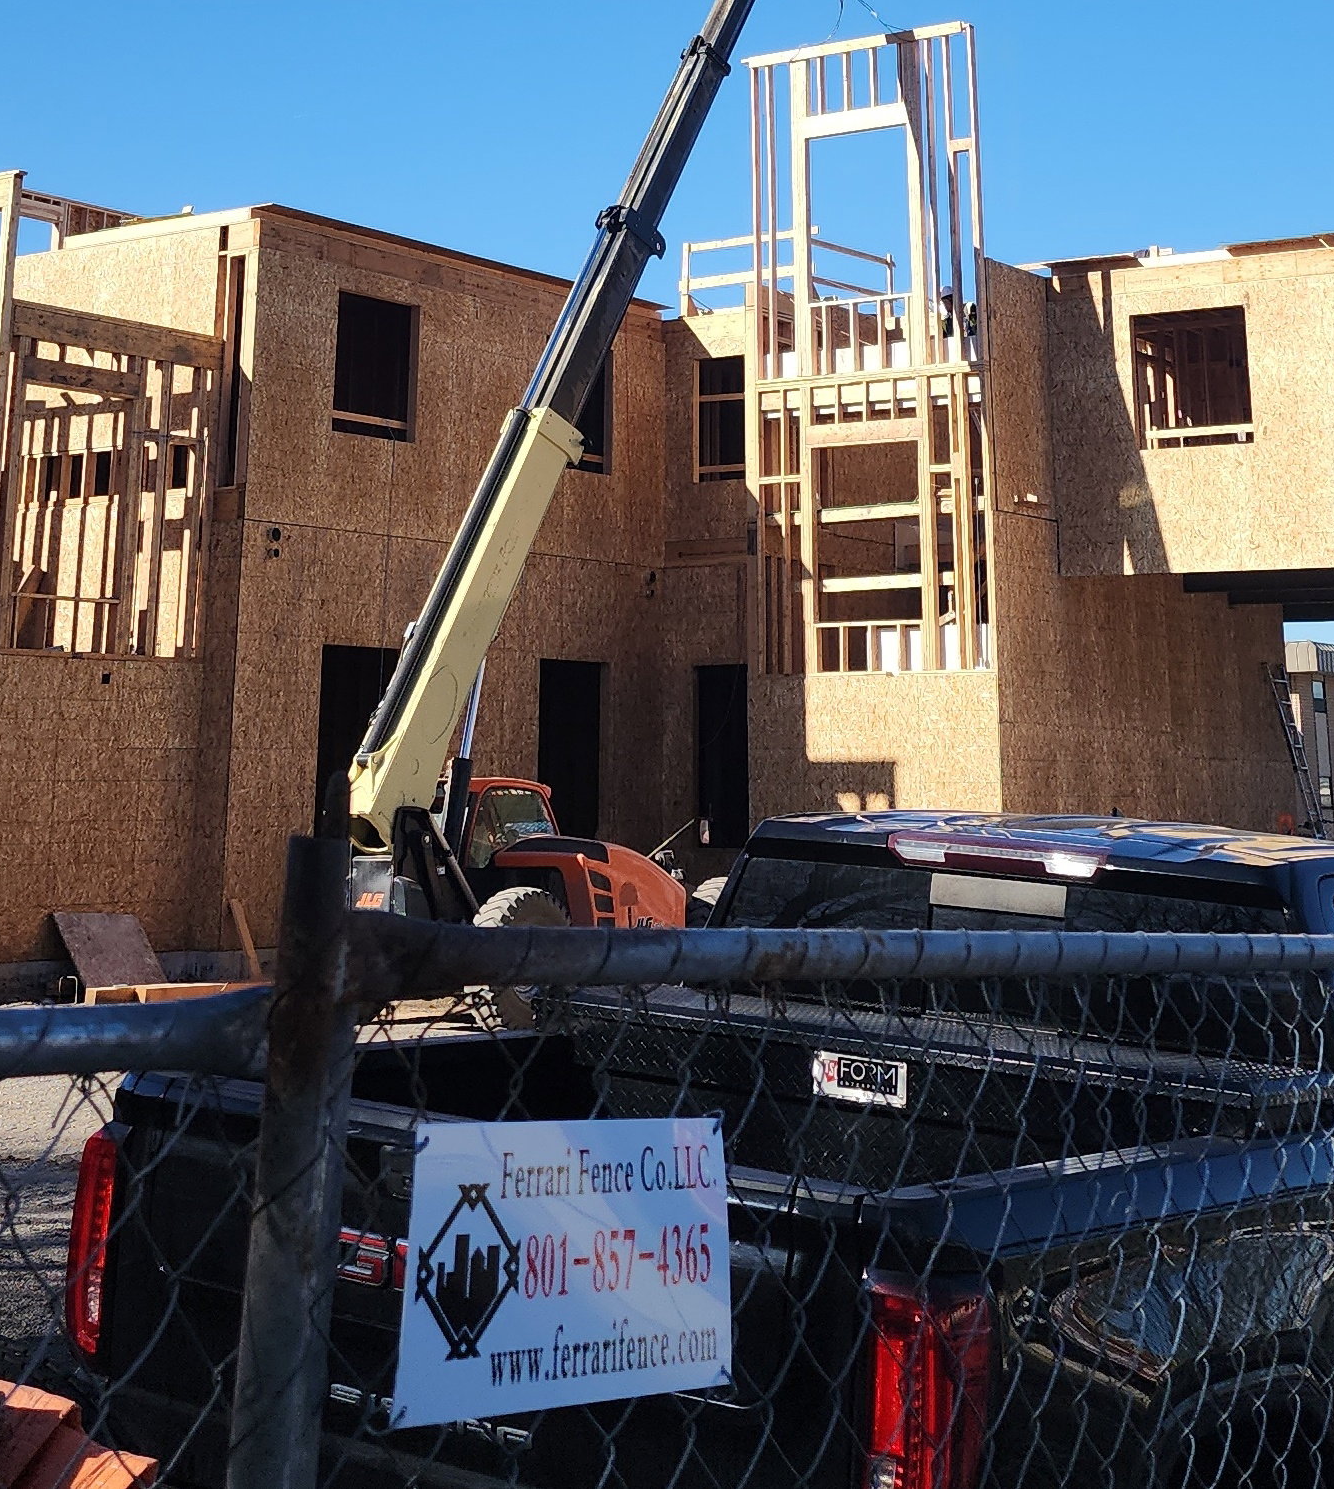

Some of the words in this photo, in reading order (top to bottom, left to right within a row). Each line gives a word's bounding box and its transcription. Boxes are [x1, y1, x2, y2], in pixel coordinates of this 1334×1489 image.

[355, 892, 385, 908] JLG
[840, 1060, 896, 1085] FORM
[500, 1146, 571, 1199] Ferrari
[576, 1149, 634, 1195] Fence
[524, 1223, 711, 1299] 801-857-4365
[490, 1318, 717, 1386] www.ferrarifence.com
